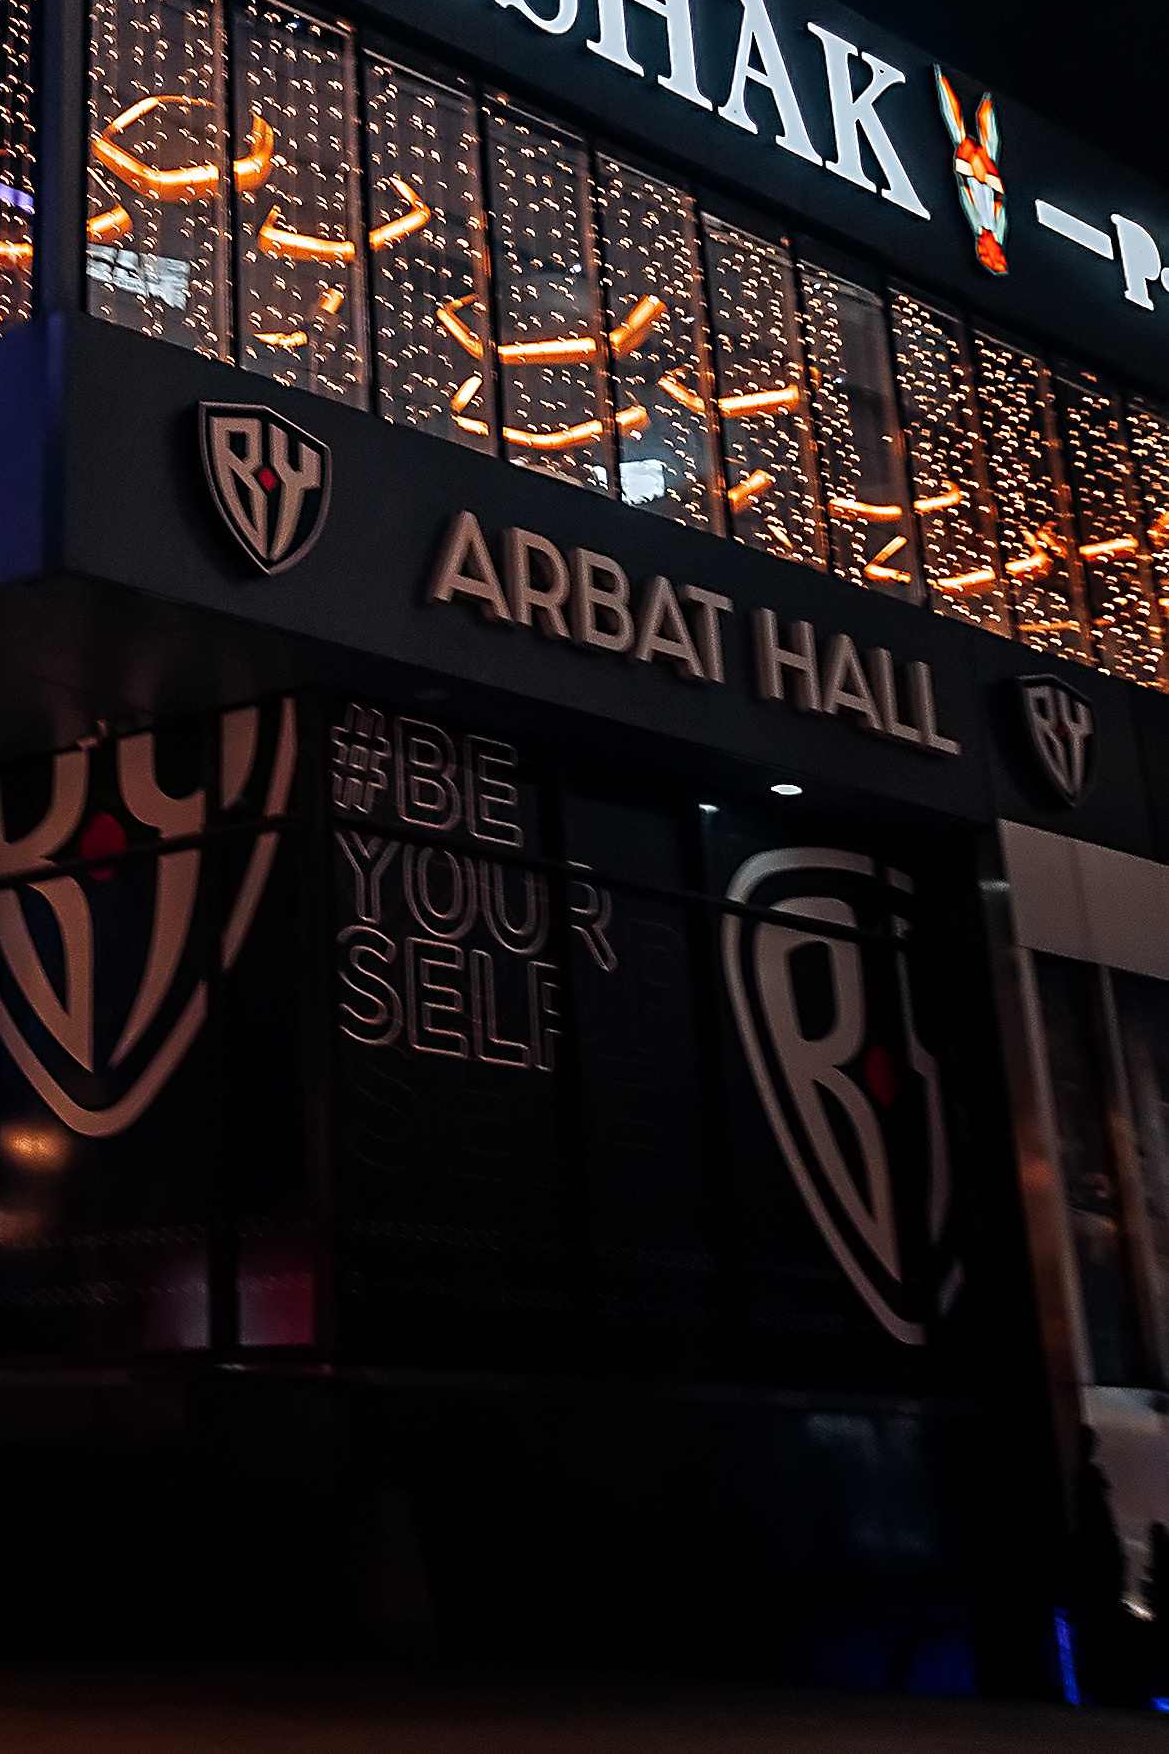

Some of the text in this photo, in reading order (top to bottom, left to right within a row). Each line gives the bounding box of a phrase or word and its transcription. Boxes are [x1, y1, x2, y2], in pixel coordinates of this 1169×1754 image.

[428, 509, 963, 757] ARBAT HALL
[330, 701, 525, 848] #BE
[333, 829, 619, 973] YOUR
[335, 924, 565, 1074] SELF
